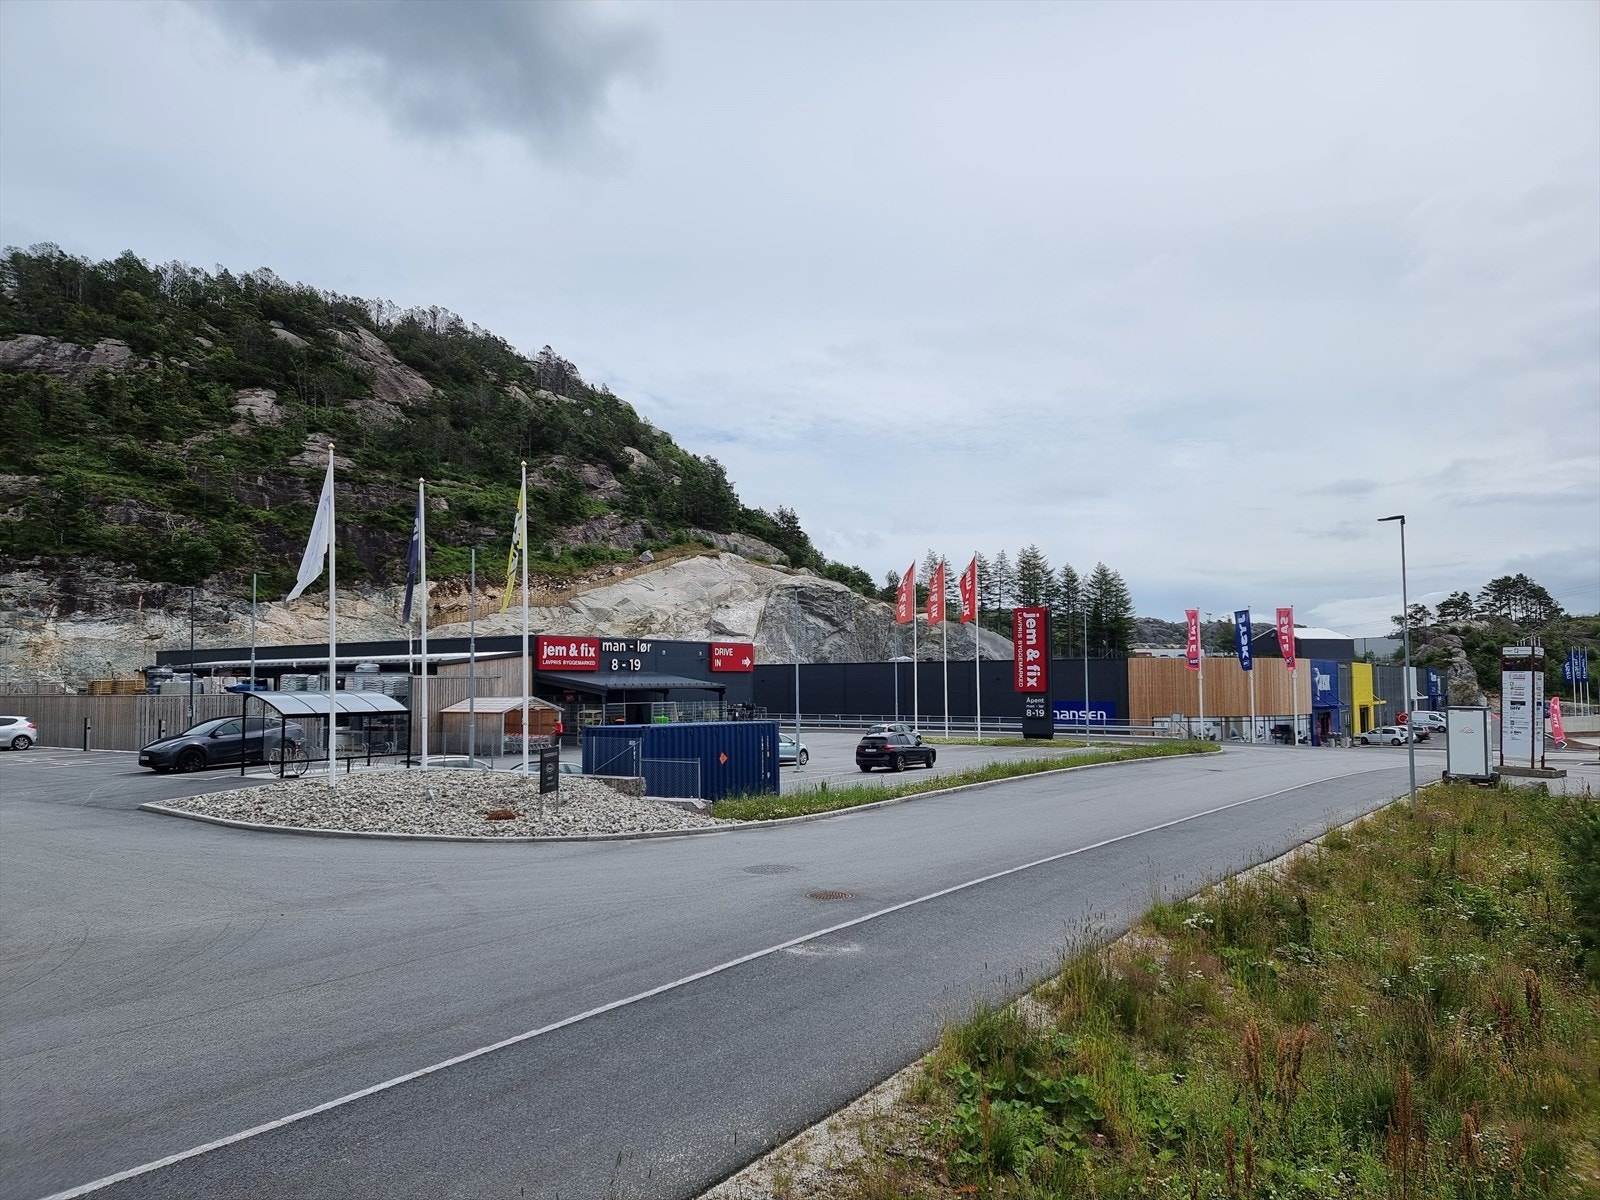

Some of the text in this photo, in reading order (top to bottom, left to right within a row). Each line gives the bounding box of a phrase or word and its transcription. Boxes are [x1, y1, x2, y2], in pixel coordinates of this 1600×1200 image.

[1023, 612, 1040, 645] jem
[542, 642, 595, 659] jem & fix
[602, 642, 626, 651] man
[637, 640, 652, 652] lør
[714, 647, 733, 656] DRIVE
[1026, 648, 1040, 662] &
[611, 658, 619, 670] 8
[629, 659, 641, 671] 19
[714, 658, 721, 667] IN
[1026, 664, 1041, 687] fix
[1026, 709, 1045, 717] 8-19
